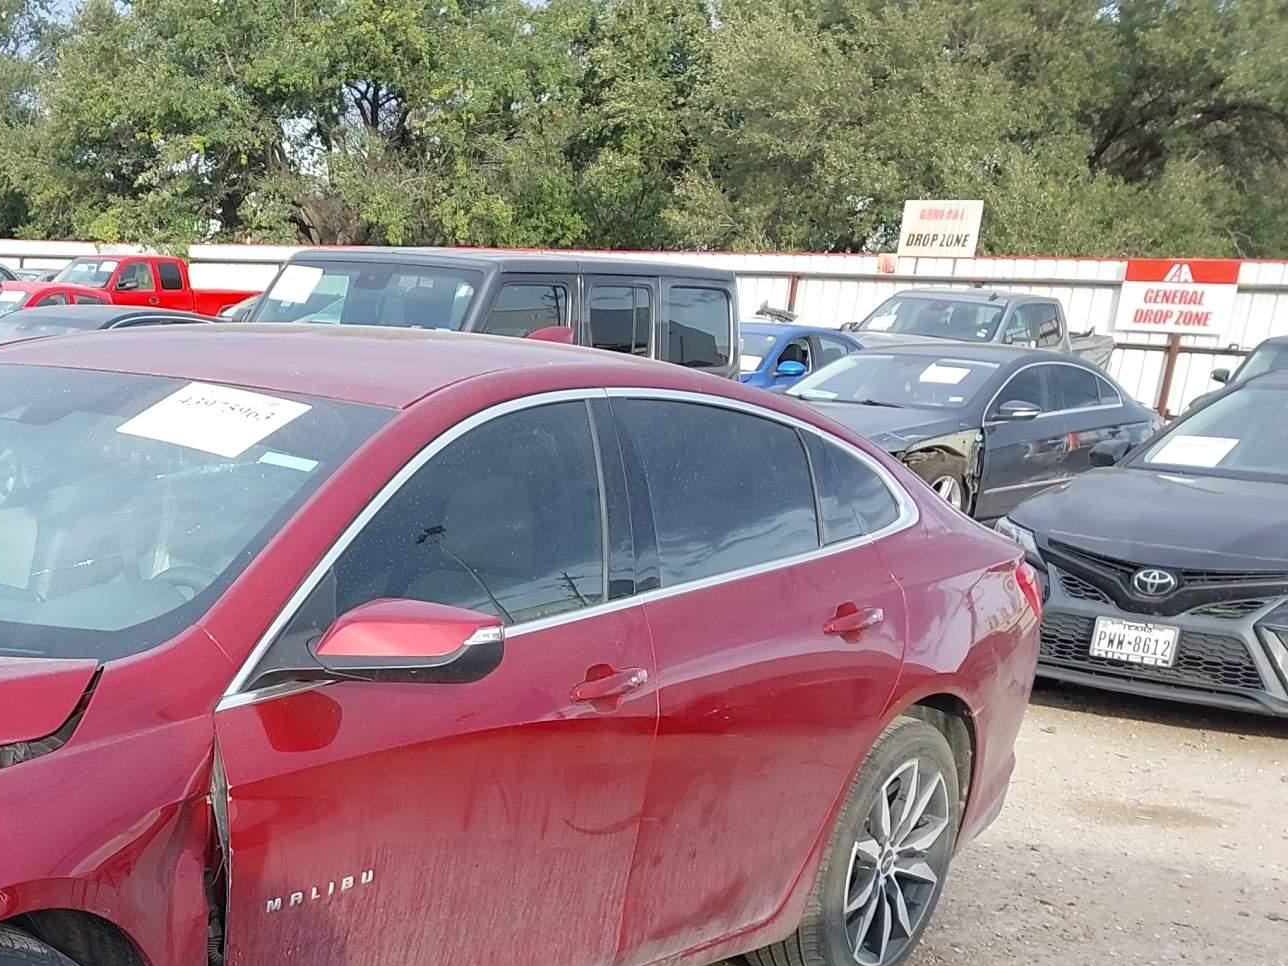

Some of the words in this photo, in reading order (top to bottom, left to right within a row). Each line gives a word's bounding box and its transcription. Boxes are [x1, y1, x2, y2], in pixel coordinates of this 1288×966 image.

[905, 233, 939, 247] DROP
[938, 233, 971, 248] ZONE
[1143, 288, 1206, 306] GENERAL
[1132, 308, 1174, 325] DROP
[1173, 310, 1214, 327] ZONE
[265, 869, 375, 914] MALIBU
